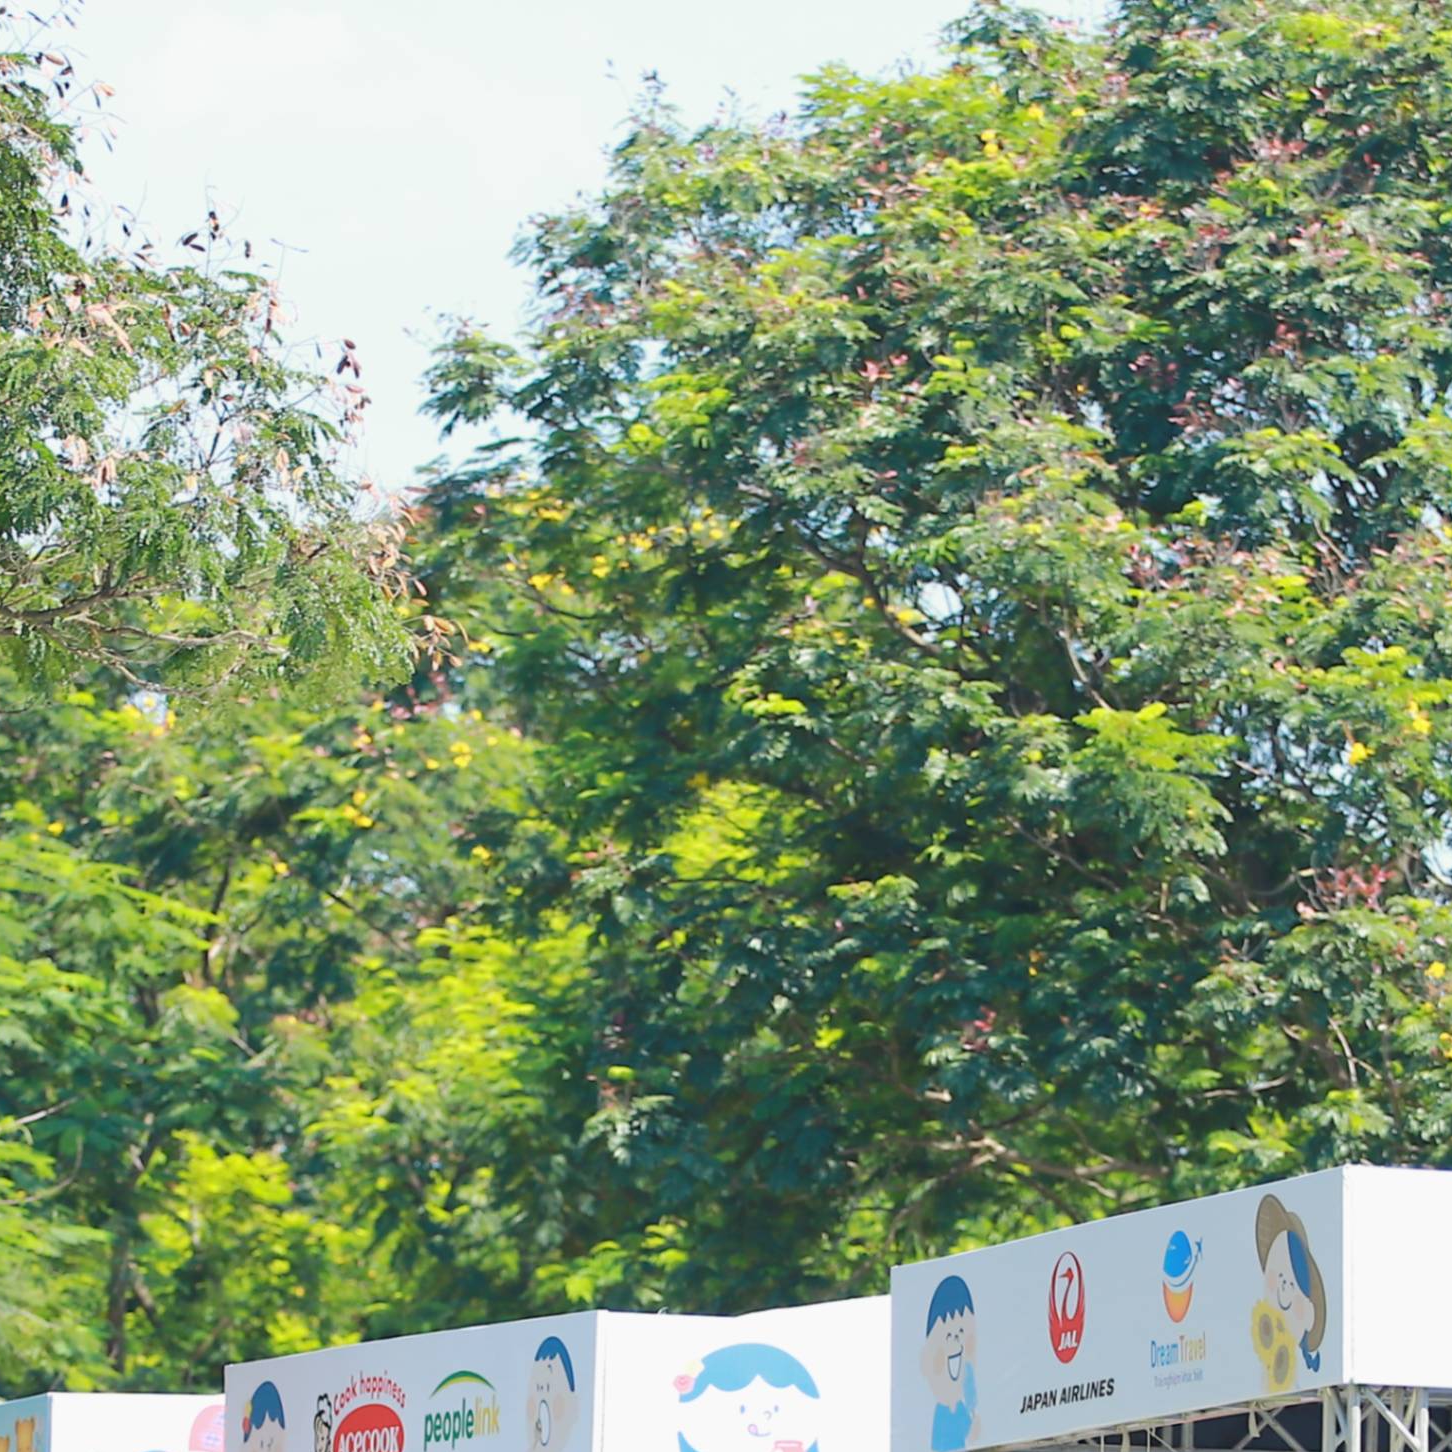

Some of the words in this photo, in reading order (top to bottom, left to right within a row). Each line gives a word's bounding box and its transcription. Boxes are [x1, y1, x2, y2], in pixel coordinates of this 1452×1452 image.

[1058, 1331, 1078, 1351] JAL
[359, 1370, 406, 1409] happiness
[1020, 1388, 1058, 1414] JAPAN
[1059, 1378, 1115, 1406] AIRLINES
